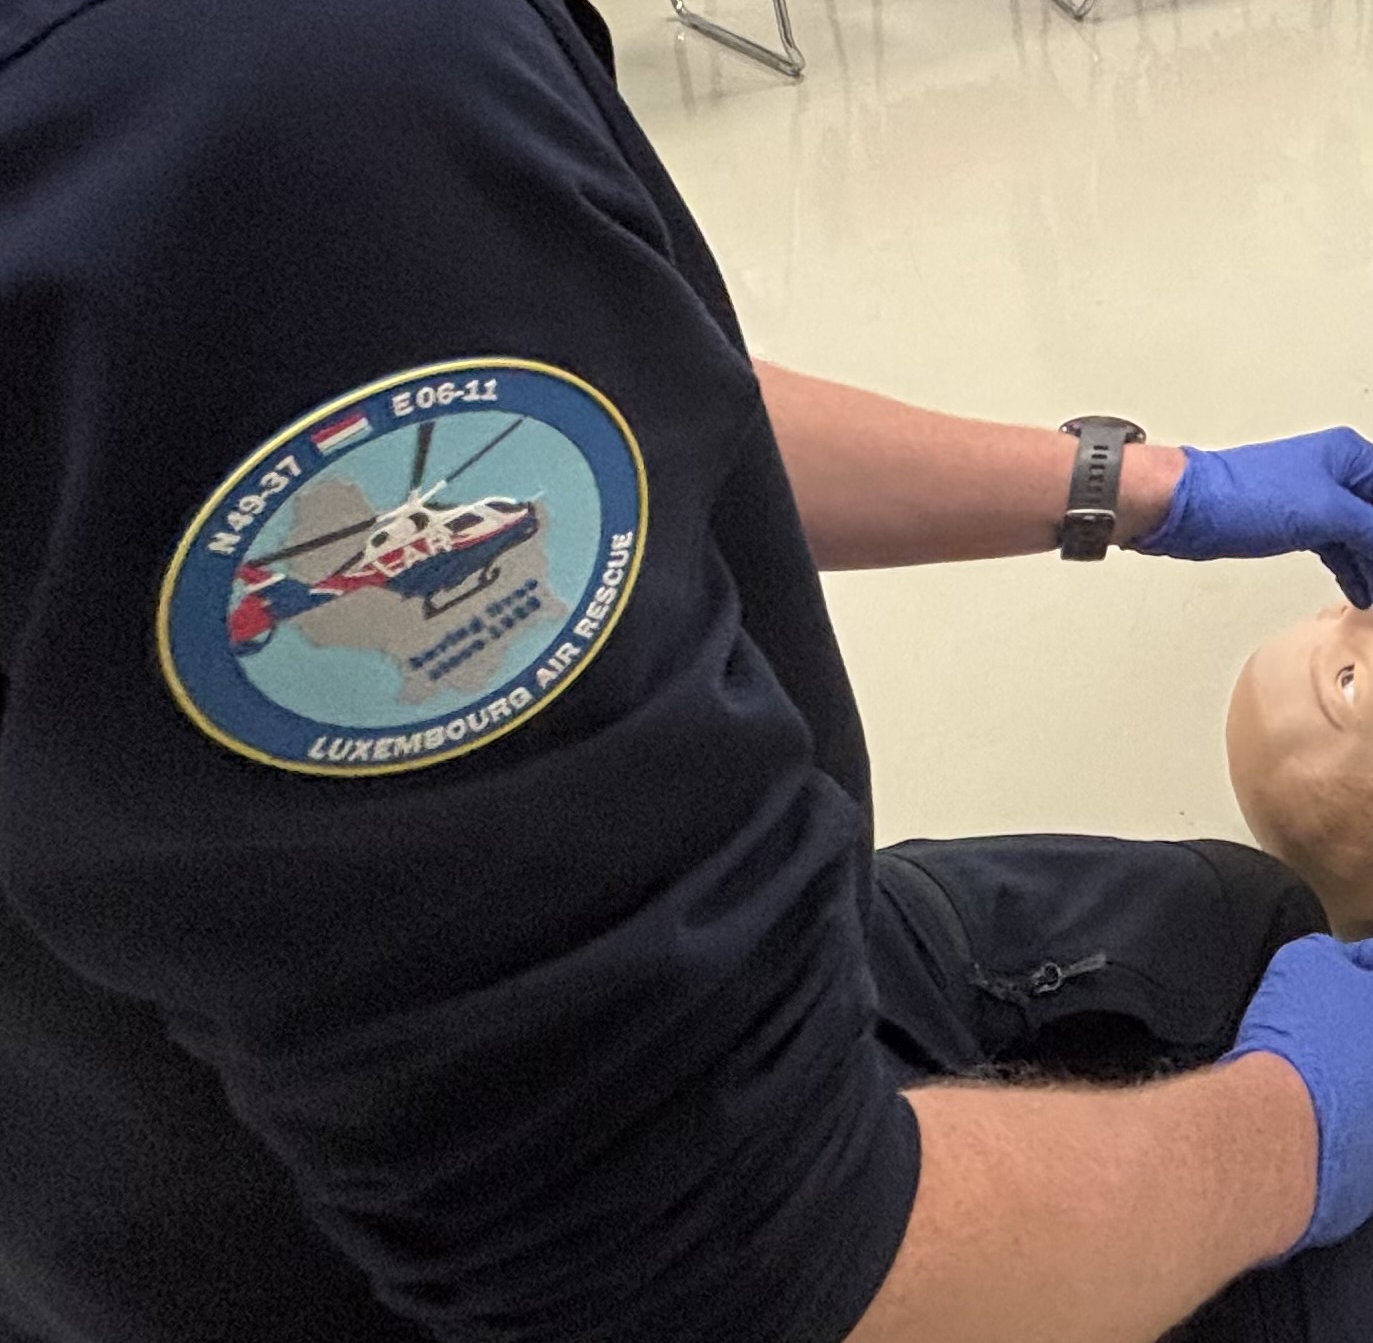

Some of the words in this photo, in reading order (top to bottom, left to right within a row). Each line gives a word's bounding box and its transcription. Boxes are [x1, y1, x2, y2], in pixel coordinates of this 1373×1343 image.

[307, 685, 535, 762] LUXEMBOURG
[535, 641, 582, 690] AIR
[572, 530, 634, 640] RESCUE
